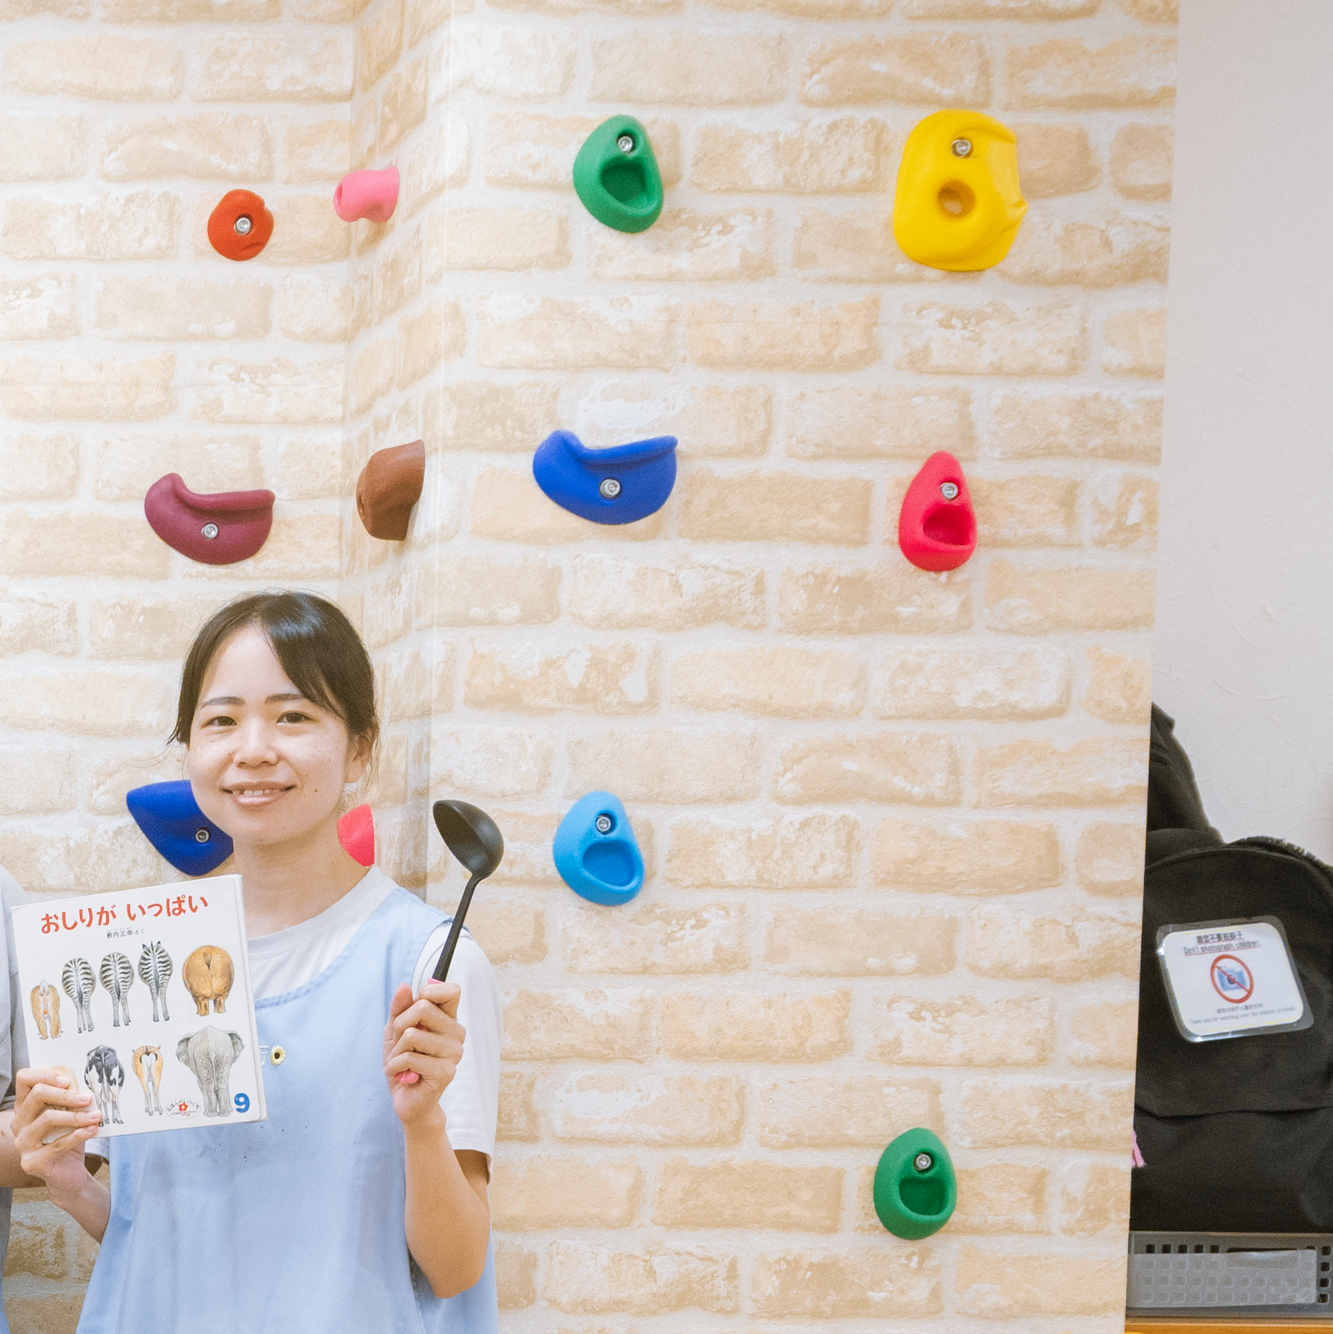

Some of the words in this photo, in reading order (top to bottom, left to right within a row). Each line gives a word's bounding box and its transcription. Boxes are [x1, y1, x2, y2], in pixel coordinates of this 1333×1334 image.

[40, 904, 117, 934] おしりが
[126, 893, 209, 922] いっぱい
[1183, 946, 1199, 955] Don't
[1201, 943, 1234, 952] photograph
[234, 1092, 250, 1113] 9
